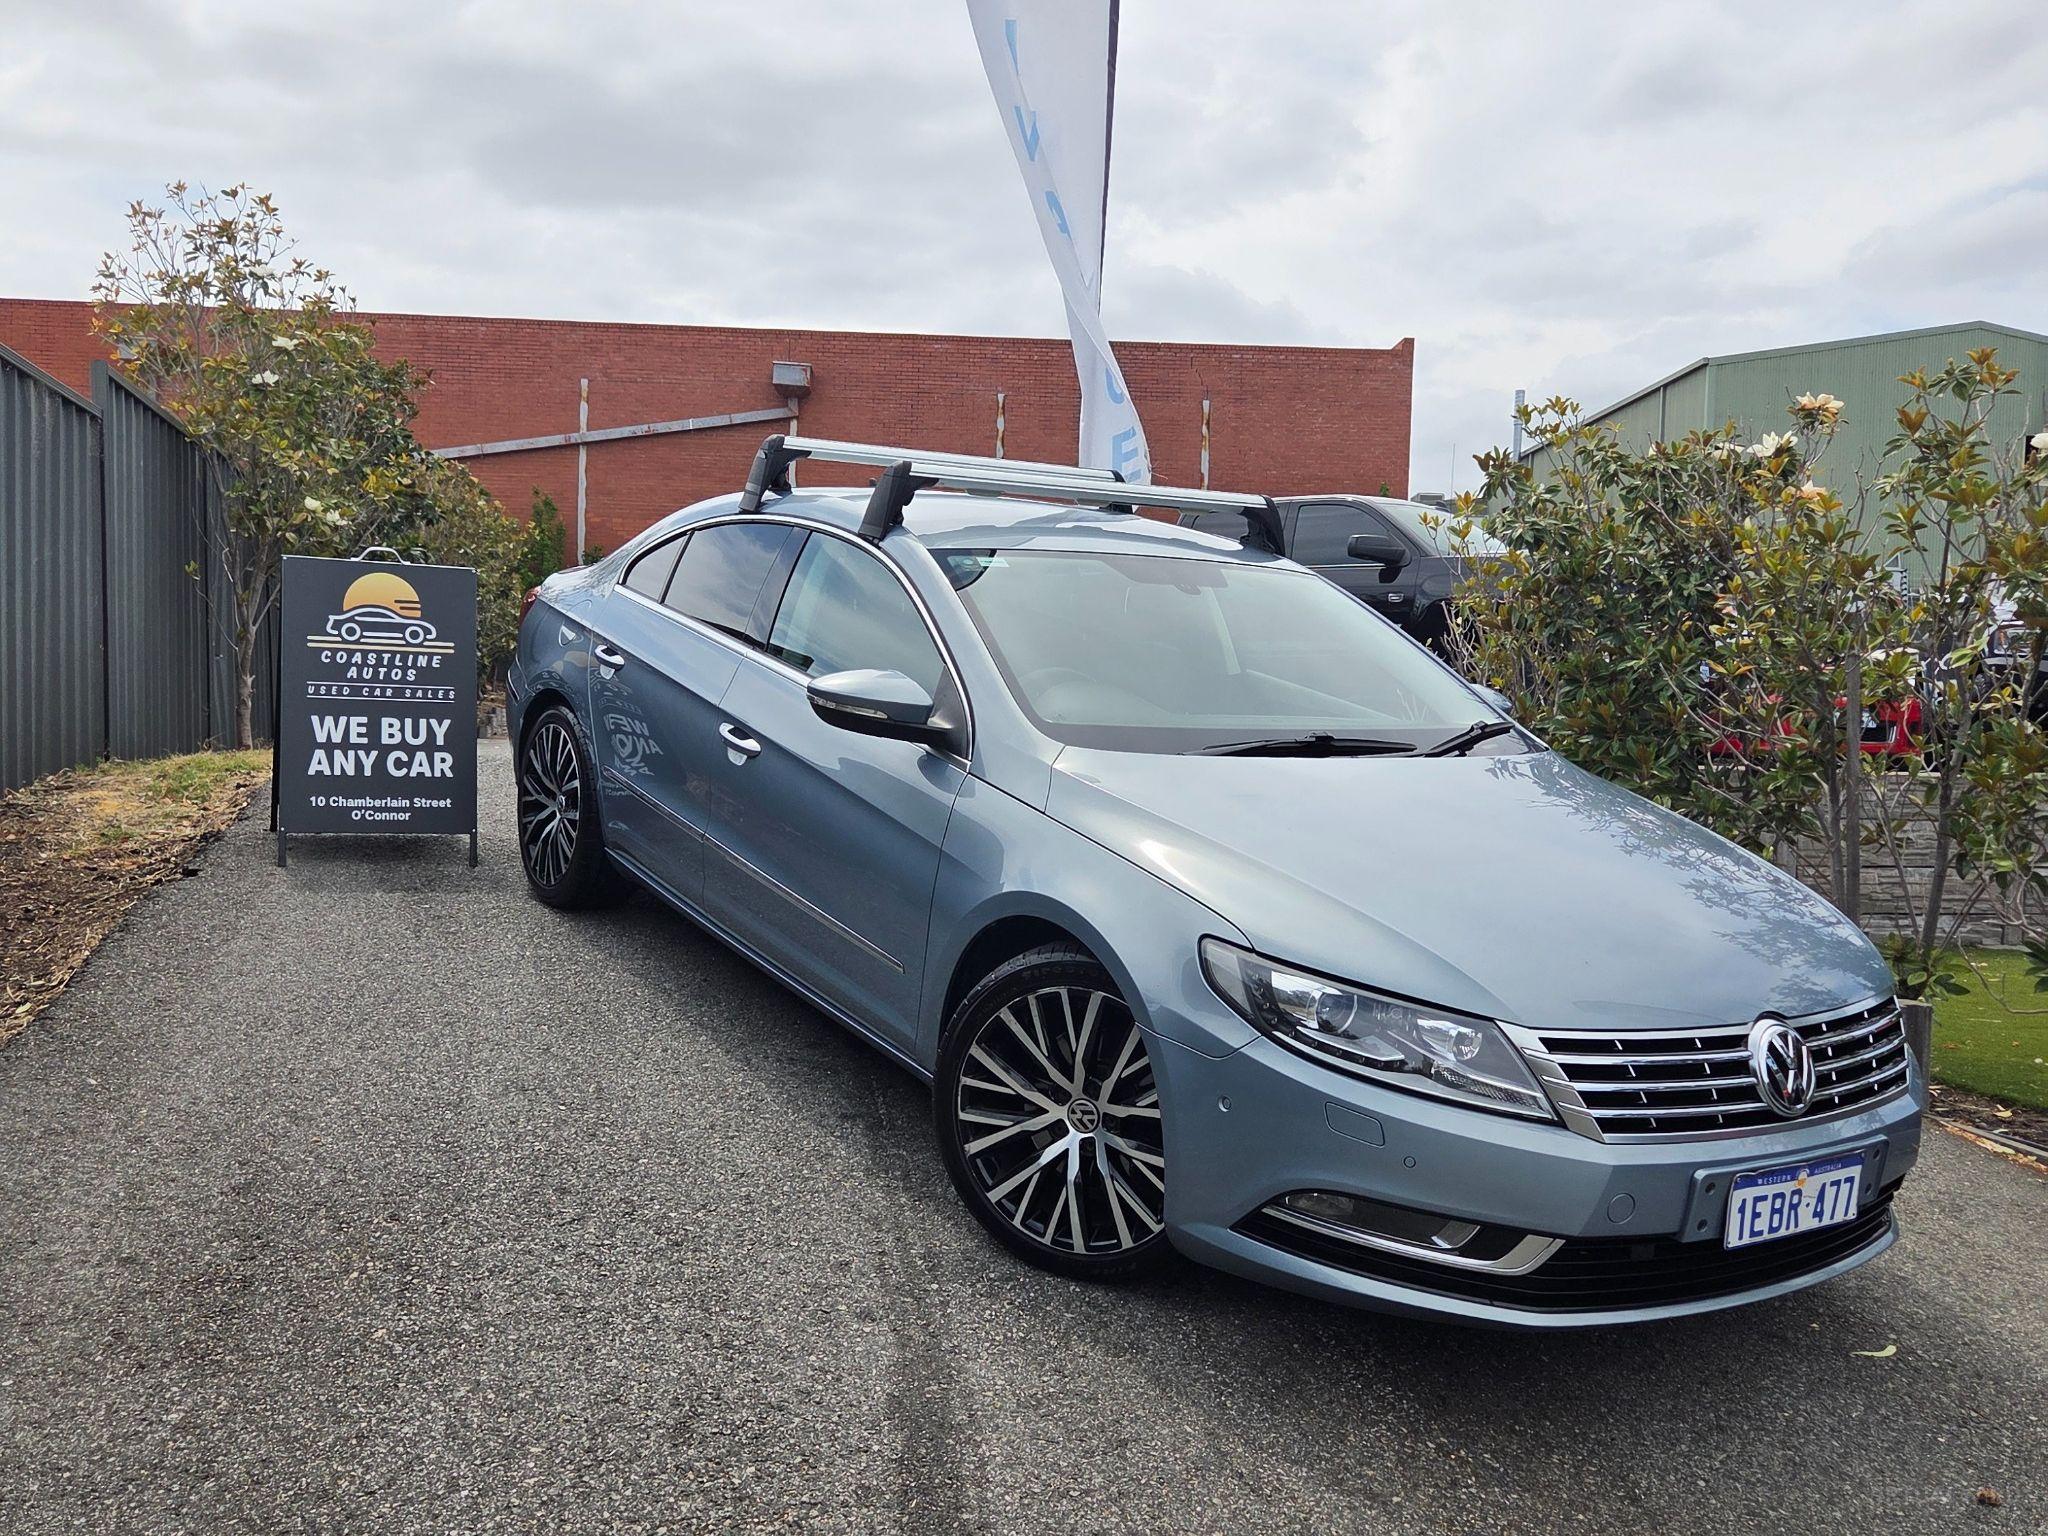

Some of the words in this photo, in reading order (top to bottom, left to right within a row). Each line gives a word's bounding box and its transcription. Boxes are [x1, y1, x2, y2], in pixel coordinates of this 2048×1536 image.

[321, 650, 442, 668] COASTLINE
[347, 666, 417, 681] AUTOS
[307, 685, 350, 695] USED
[362, 687, 393, 697] CAR
[405, 688, 456, 699] SALES
[310, 715, 369, 744] WE
[381, 717, 452, 746] BUY
[307, 749, 379, 777] ANY
[386, 750, 454, 778] CAR
[309, 796, 326, 807] 10
[329, 796, 410, 808] Chamberlain
[413, 797, 452, 808] Street
[351, 810, 411, 821] O'Connor
[1758, 1174, 1792, 1185] WESTERN
[1814, 1163, 1842, 1174] AUSTRALIA
